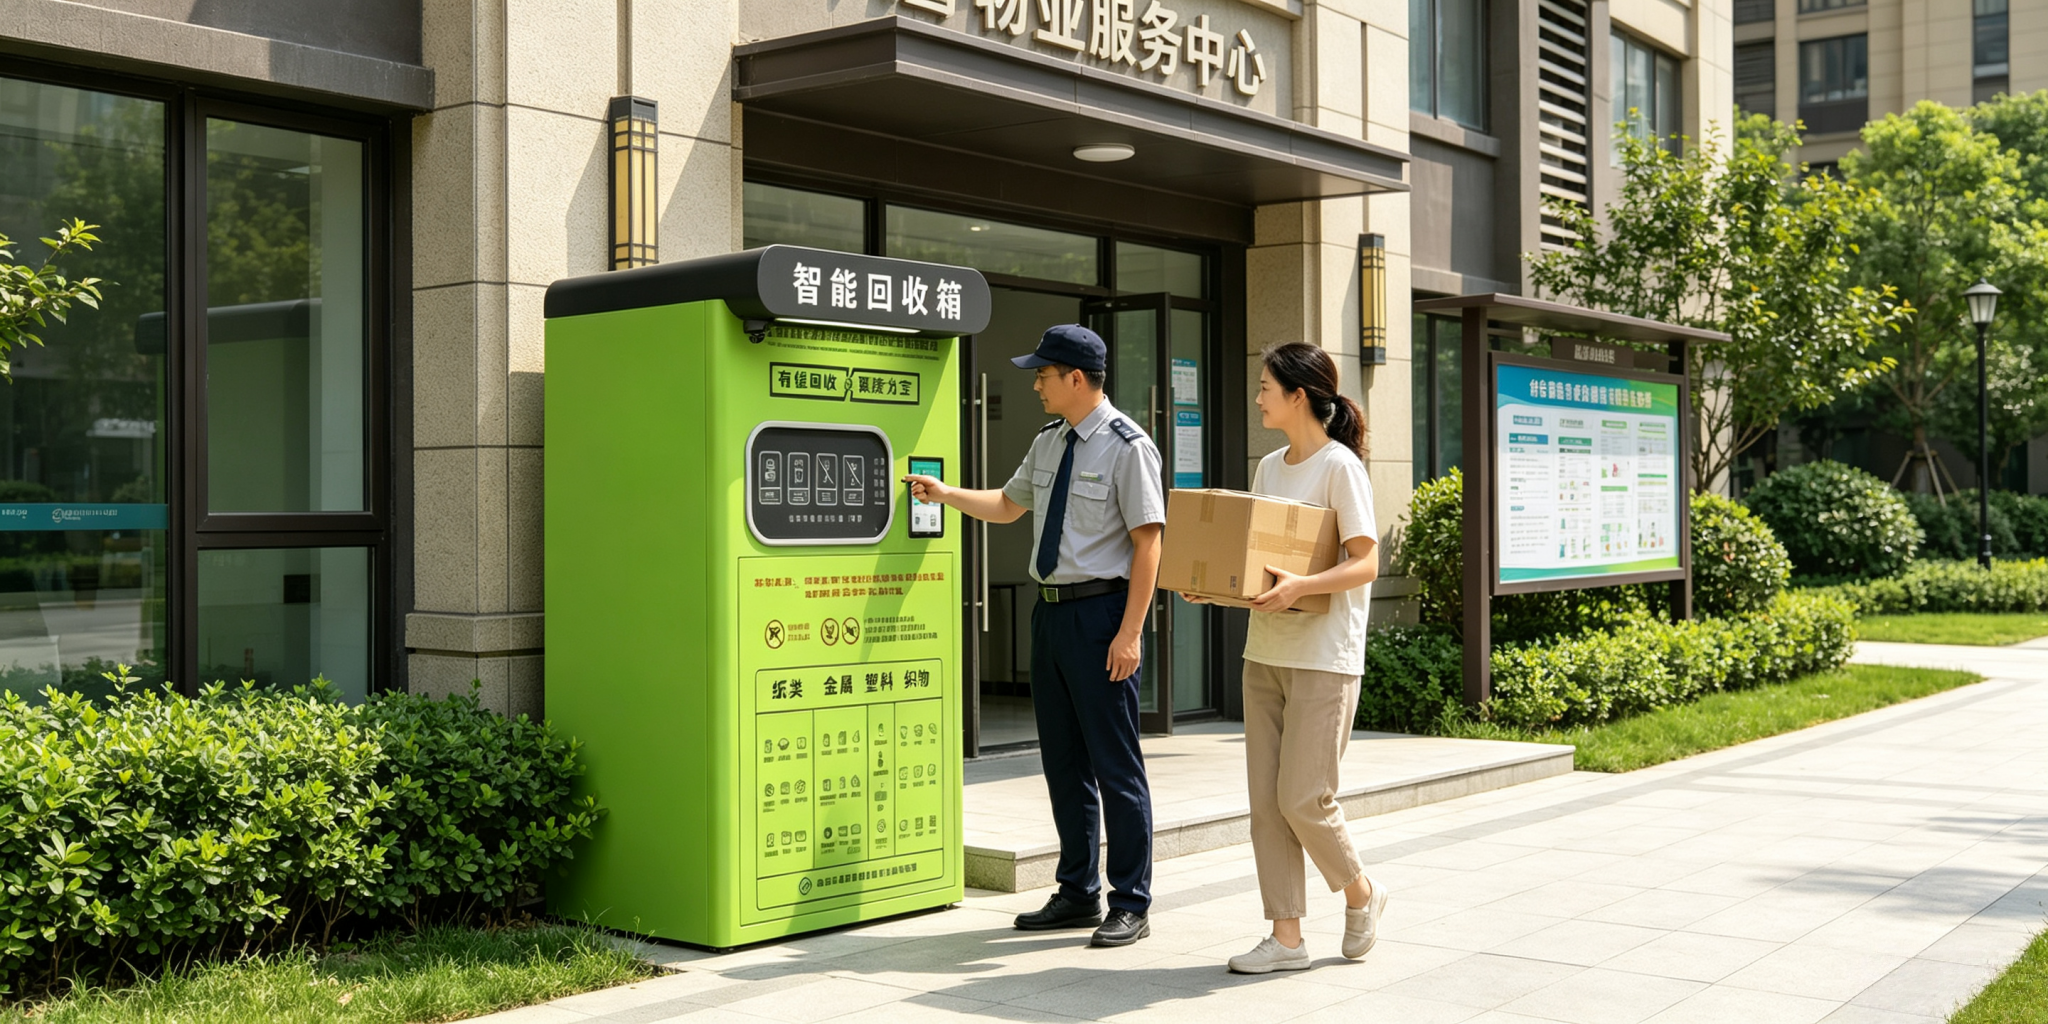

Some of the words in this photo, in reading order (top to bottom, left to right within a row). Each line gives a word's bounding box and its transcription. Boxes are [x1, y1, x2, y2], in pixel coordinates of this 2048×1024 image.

[901, 0, 1267, 96] 业服务中心
[793, 262, 962, 320] 智能回收箱
[824, 675, 853, 696] 金属
